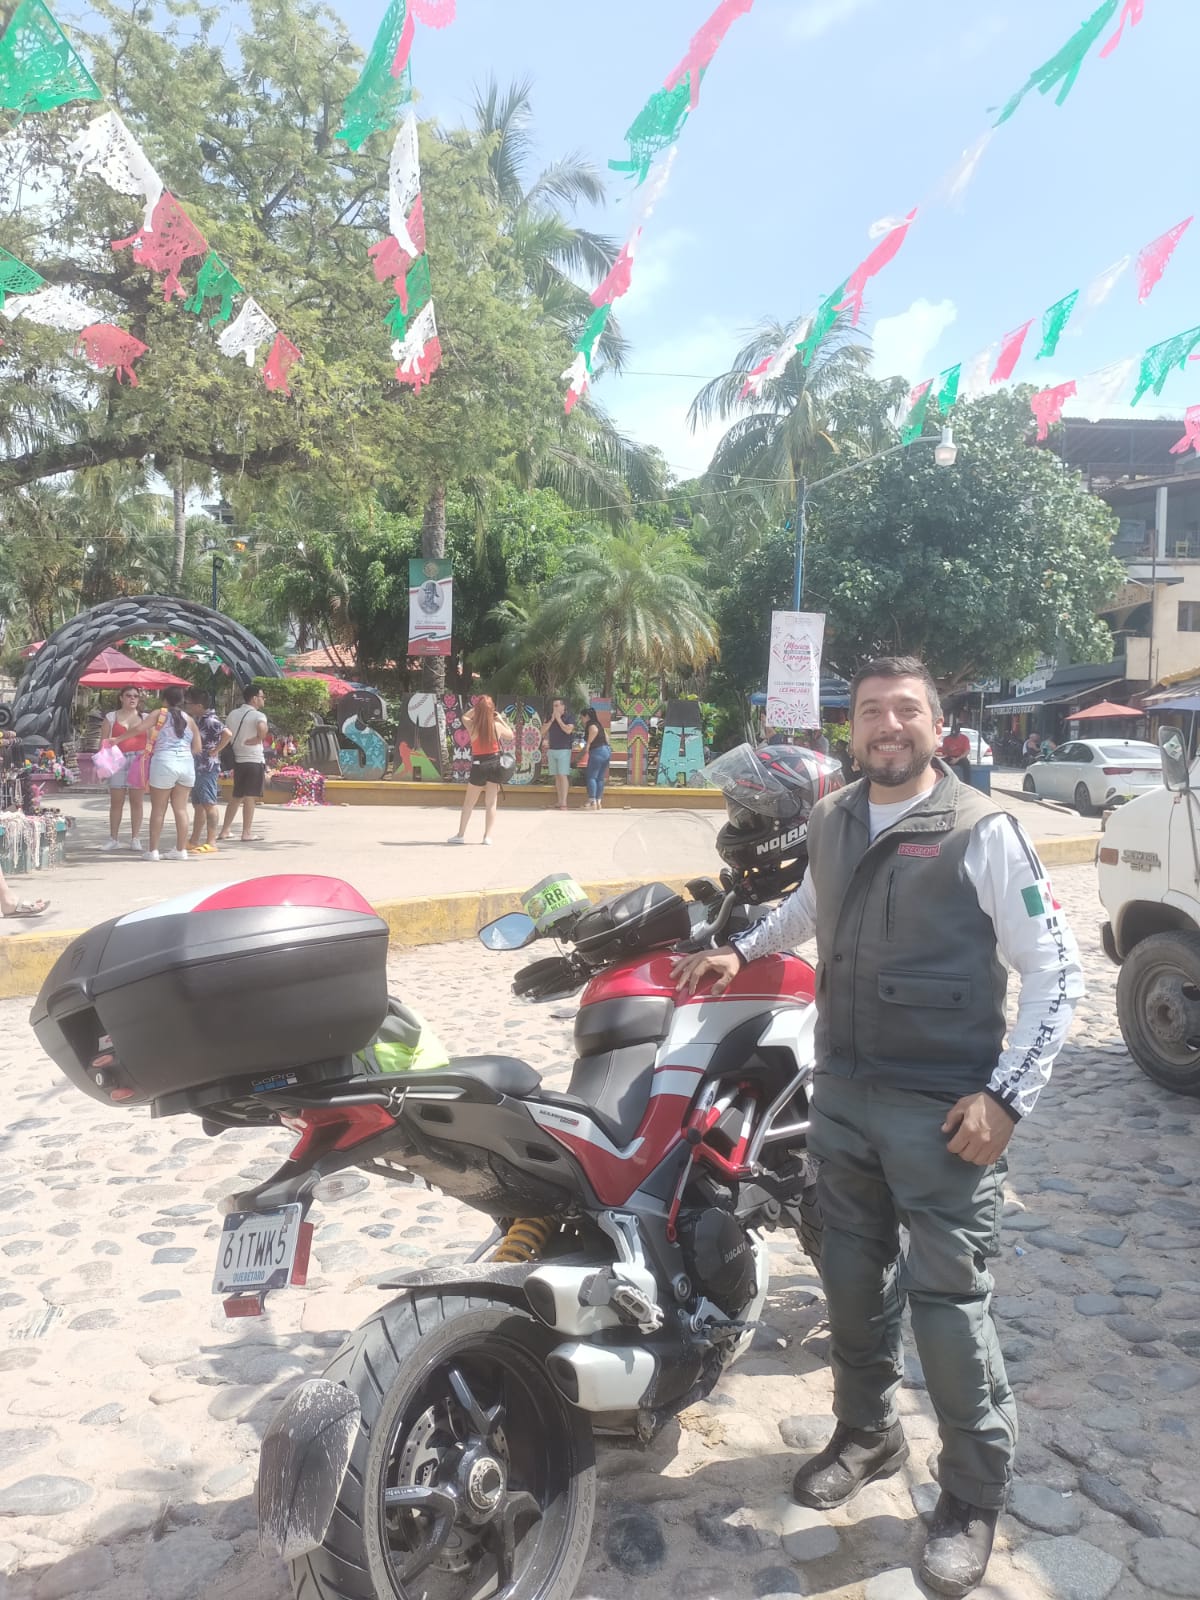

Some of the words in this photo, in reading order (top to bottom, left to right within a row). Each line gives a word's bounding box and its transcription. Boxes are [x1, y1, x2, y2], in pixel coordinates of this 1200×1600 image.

[544, 888, 565, 906] RR
[223, 1230, 288, 1269] 61TWK5
[724, 1241, 746, 1264] DUCATI
